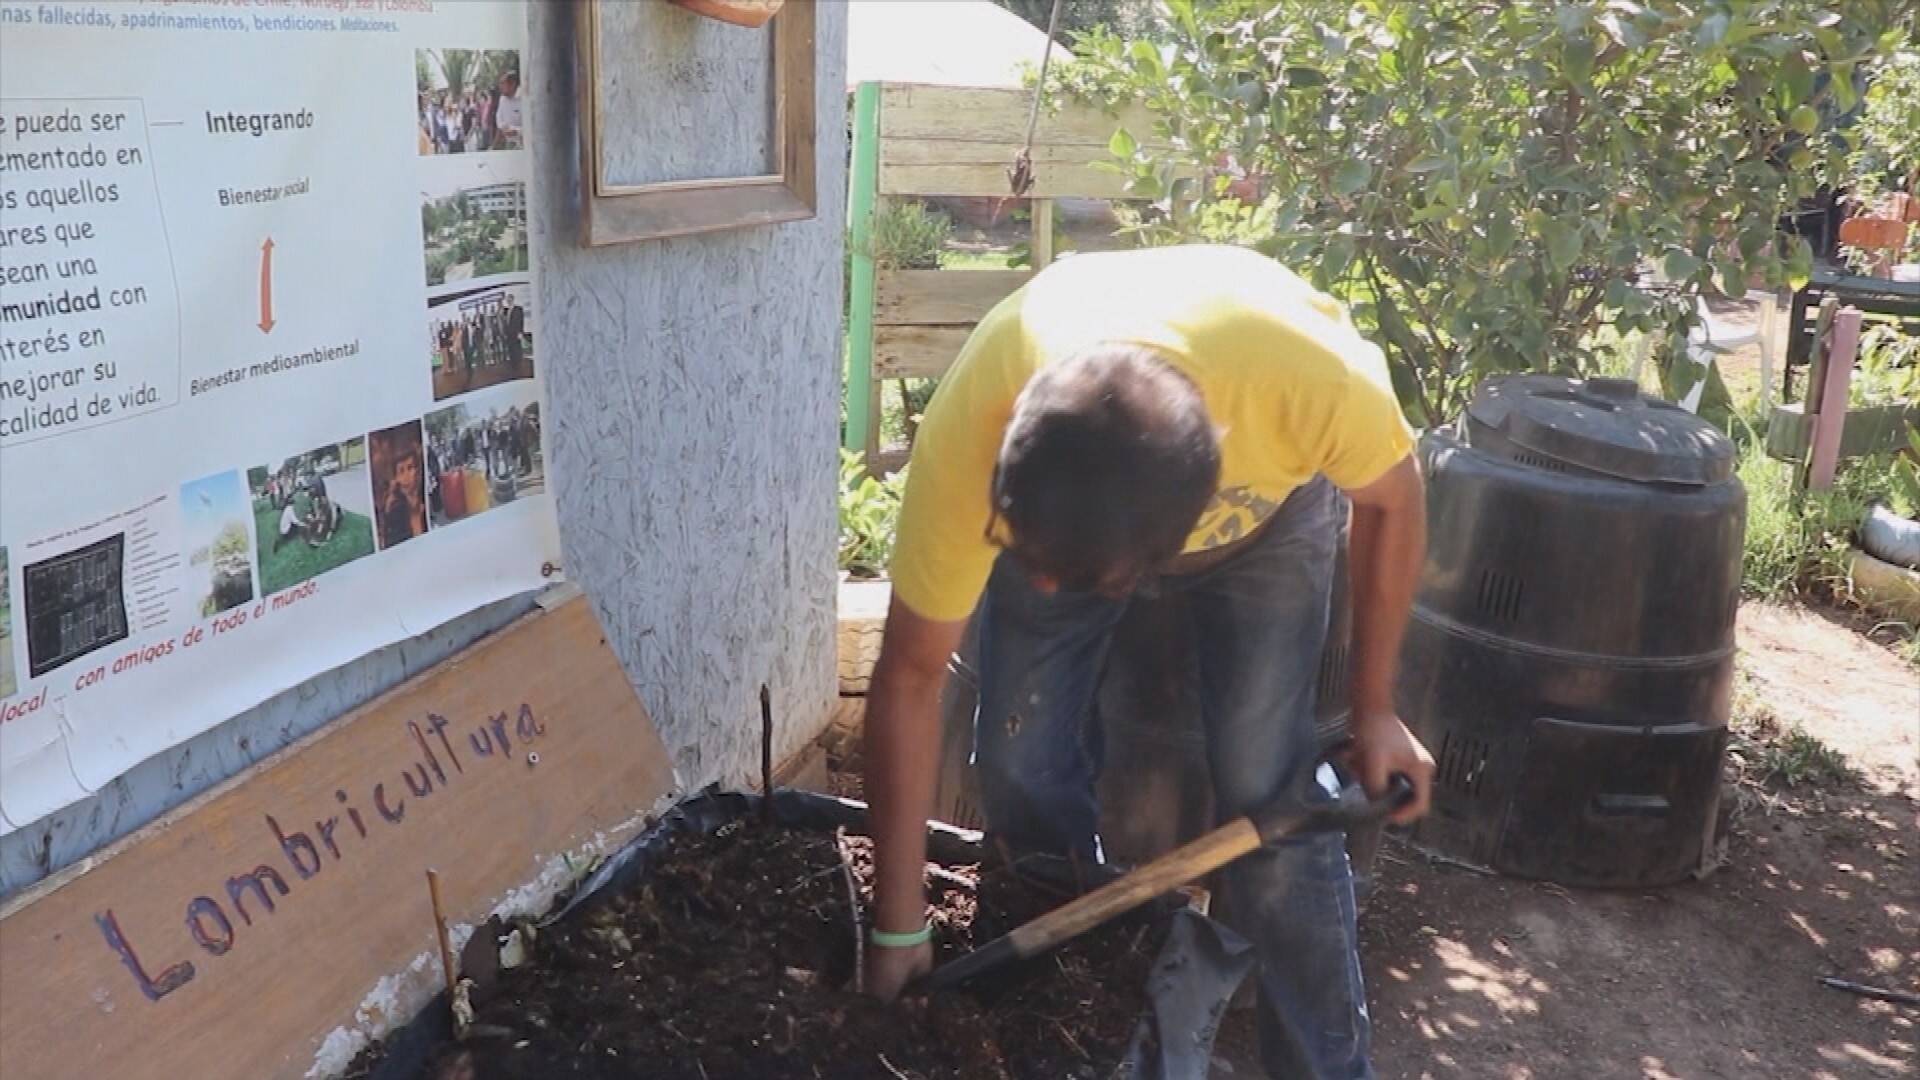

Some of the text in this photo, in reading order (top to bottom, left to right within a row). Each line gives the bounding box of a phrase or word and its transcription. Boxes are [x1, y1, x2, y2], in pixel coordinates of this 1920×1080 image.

[2, 7, 33, 23] nas
[38, 5, 116, 29] fallecidas,
[121, 12, 249, 32] apadrinamientos,
[16, 107, 82, 141] pueda
[91, 113, 126, 132] ser
[206, 107, 314, 137] Integrando
[117, 147, 142, 165] en
[26, 179, 119, 213] aquellos
[218, 177, 310, 206] Bienestar social
[54, 221, 95, 248] que
[56, 257, 97, 278] una
[0, 286, 147, 322] munidad con
[79, 328, 105, 348] en
[94, 361, 117, 381] su
[191, 339, 360, 396] Bienestar medioambiental
[0, 398, 79, 437] calidad
[87, 392, 112, 417] de
[0, 684, 48, 726] local
[75, 665, 105, 691] con
[112, 637, 176, 675] amigos
[183, 625, 203, 648] de
[211, 610, 248, 637] todo
[252, 597, 266, 620] el
[95, 703, 545, 1001] Lombricultura
